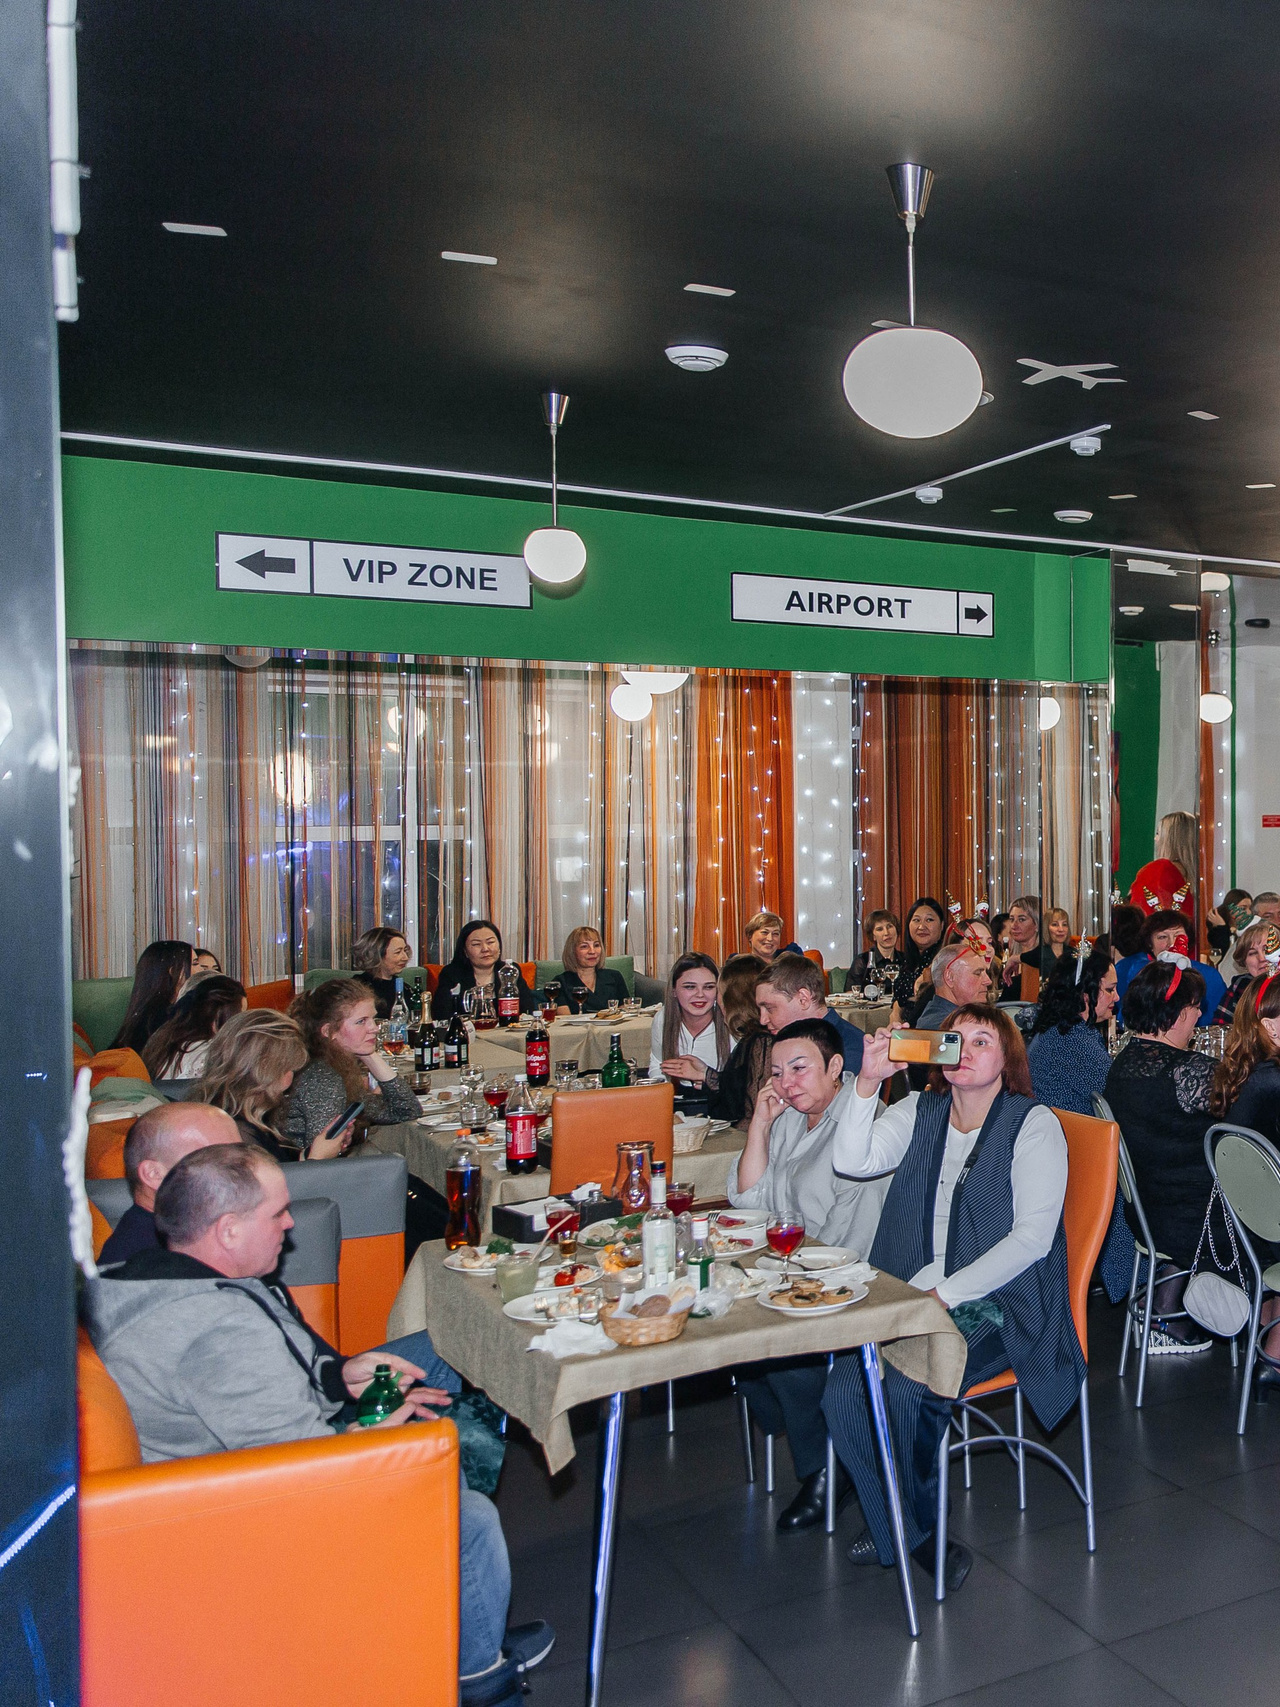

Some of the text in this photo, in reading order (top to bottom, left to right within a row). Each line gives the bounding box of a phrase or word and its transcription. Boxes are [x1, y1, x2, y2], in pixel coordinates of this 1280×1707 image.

[342, 558, 498, 591] VIP ZONE
[785, 590, 912, 619] AIRPORT
